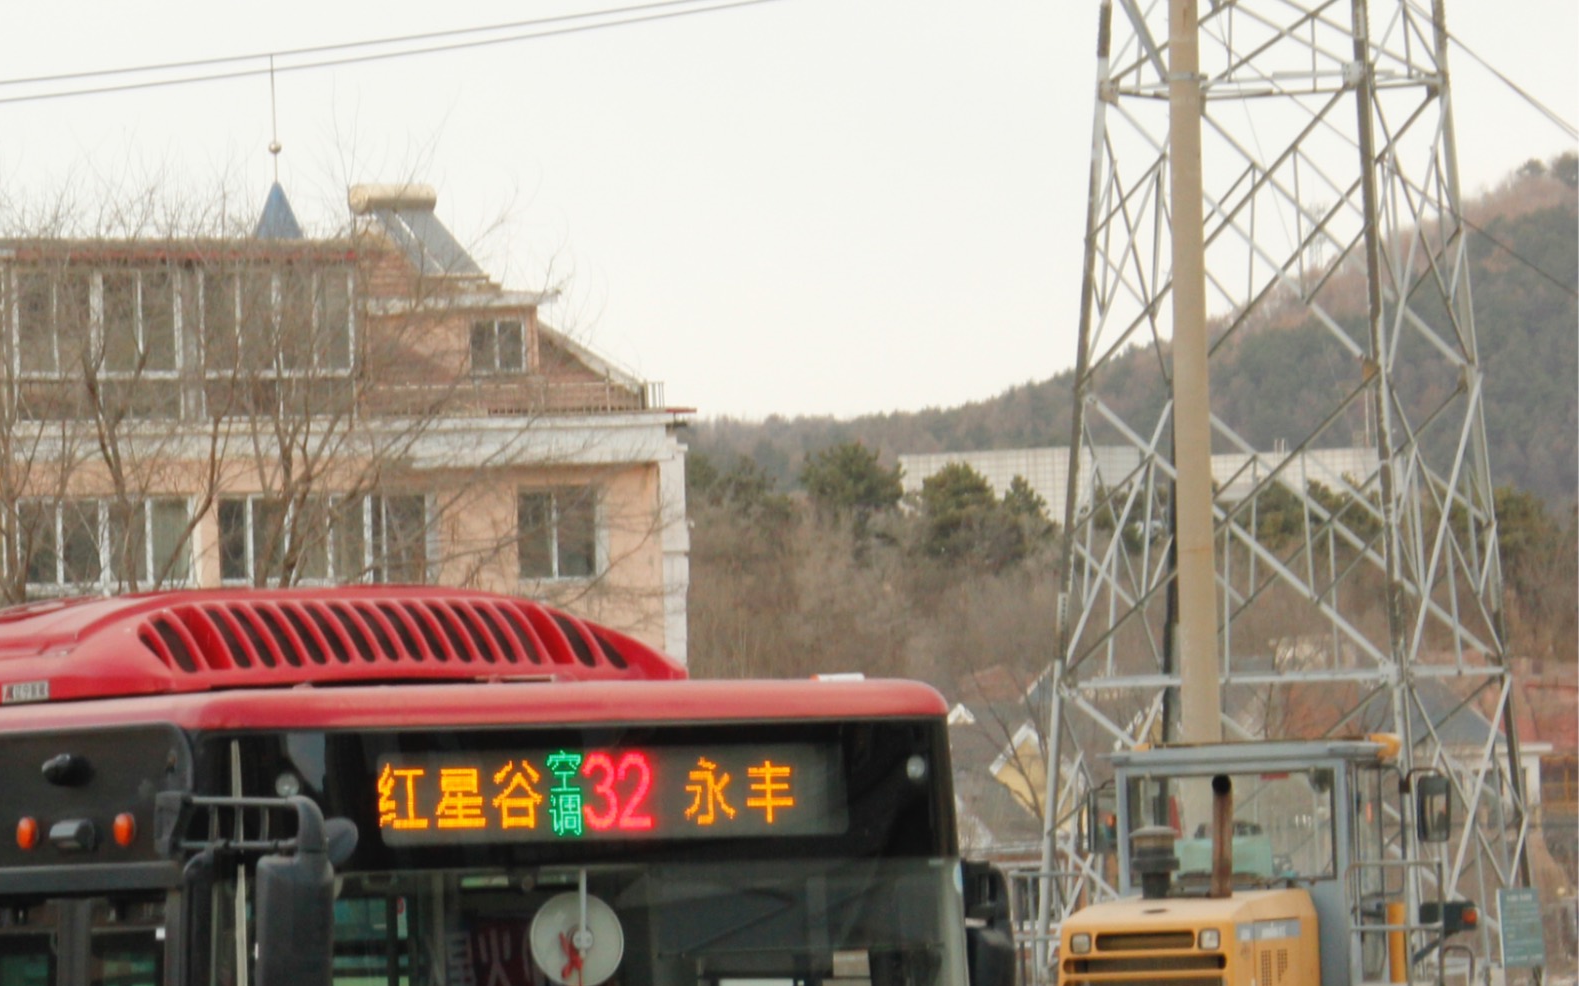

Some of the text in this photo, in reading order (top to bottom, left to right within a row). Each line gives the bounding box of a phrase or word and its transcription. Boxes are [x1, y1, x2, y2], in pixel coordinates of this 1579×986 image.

[377, 761, 543, 830] 红星谷
[547, 750, 583, 837] 空调
[582, 752, 653, 830] 32
[685, 757, 795, 826] 永丰
